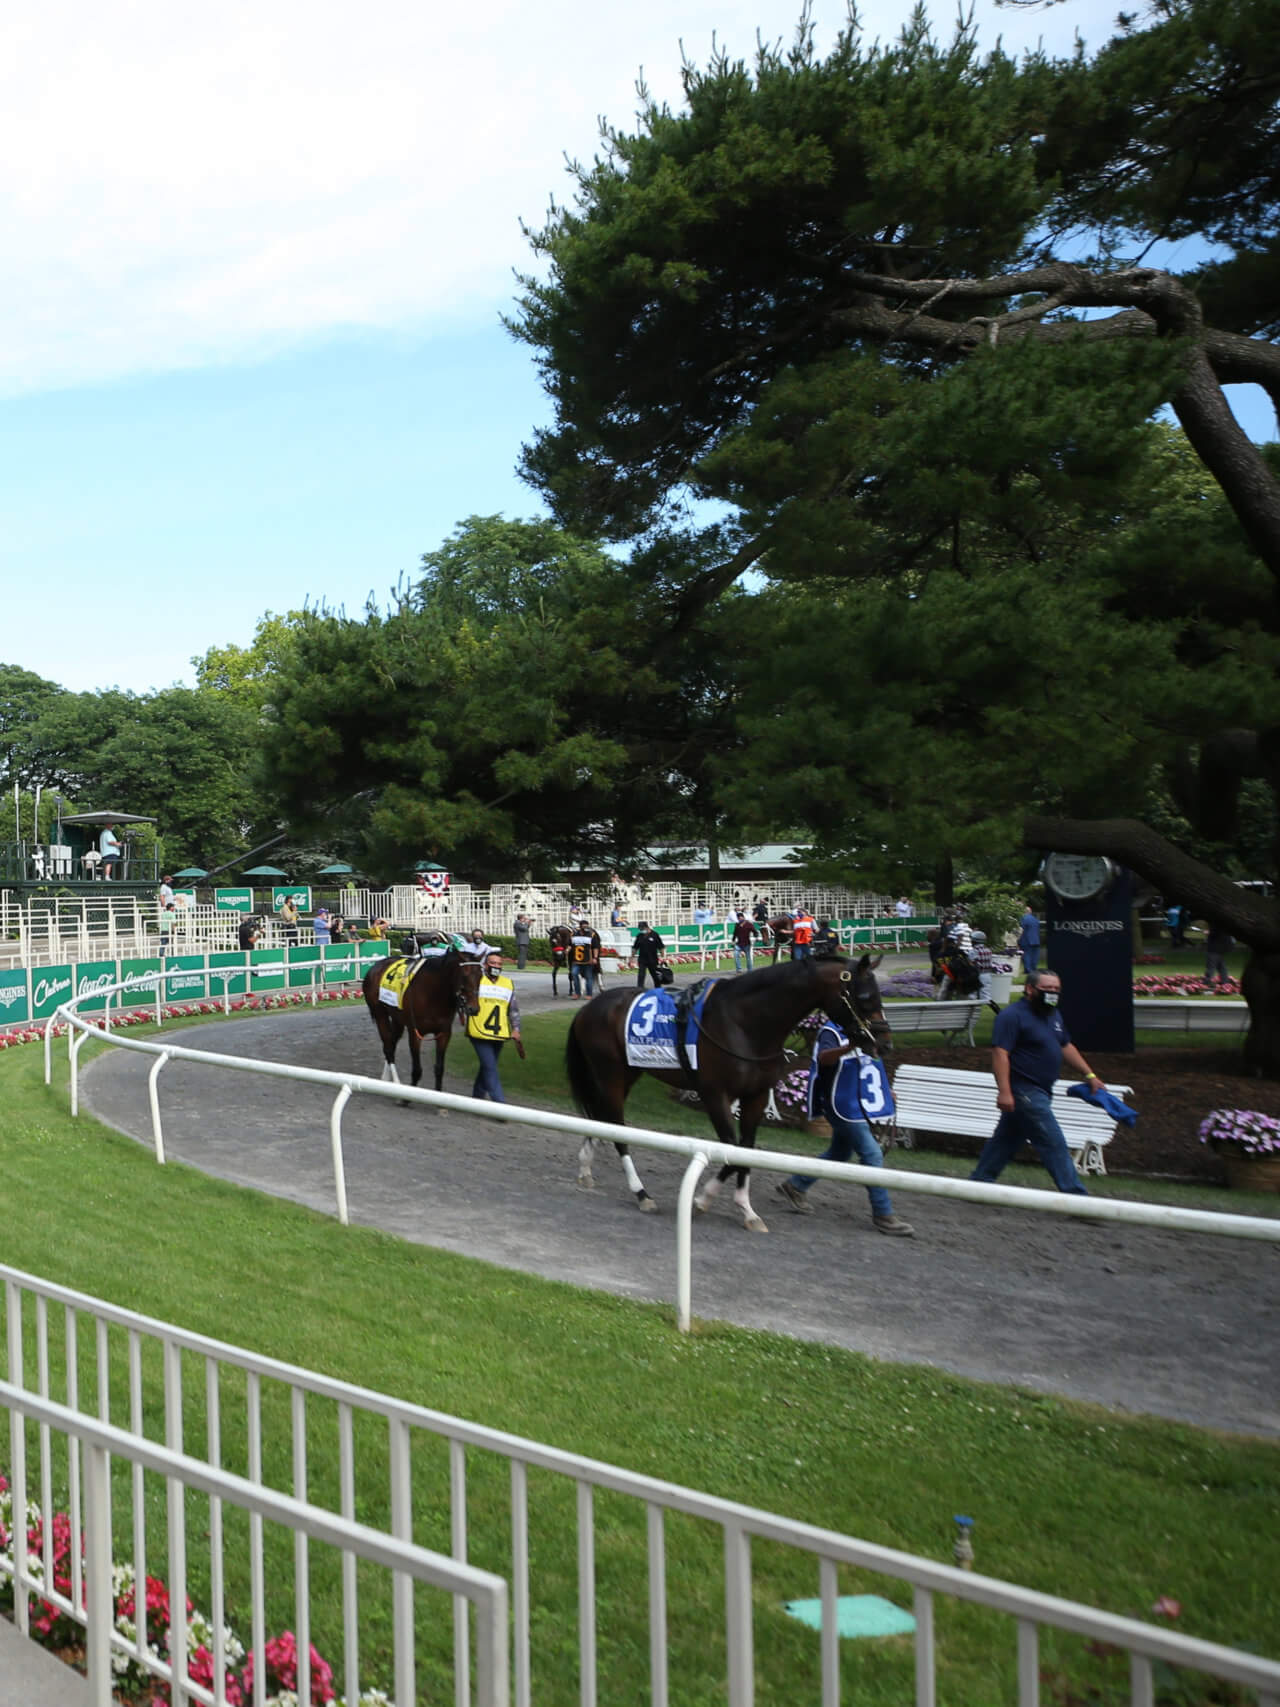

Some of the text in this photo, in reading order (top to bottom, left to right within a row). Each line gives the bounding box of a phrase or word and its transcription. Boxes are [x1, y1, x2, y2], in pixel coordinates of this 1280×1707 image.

[1054, 921, 1124, 930] LONGINES
[575, 945, 585, 961] 6
[484, 1005, 501, 1035] 4
[631, 995, 658, 1036] 3
[859, 1064, 885, 1112] 3
